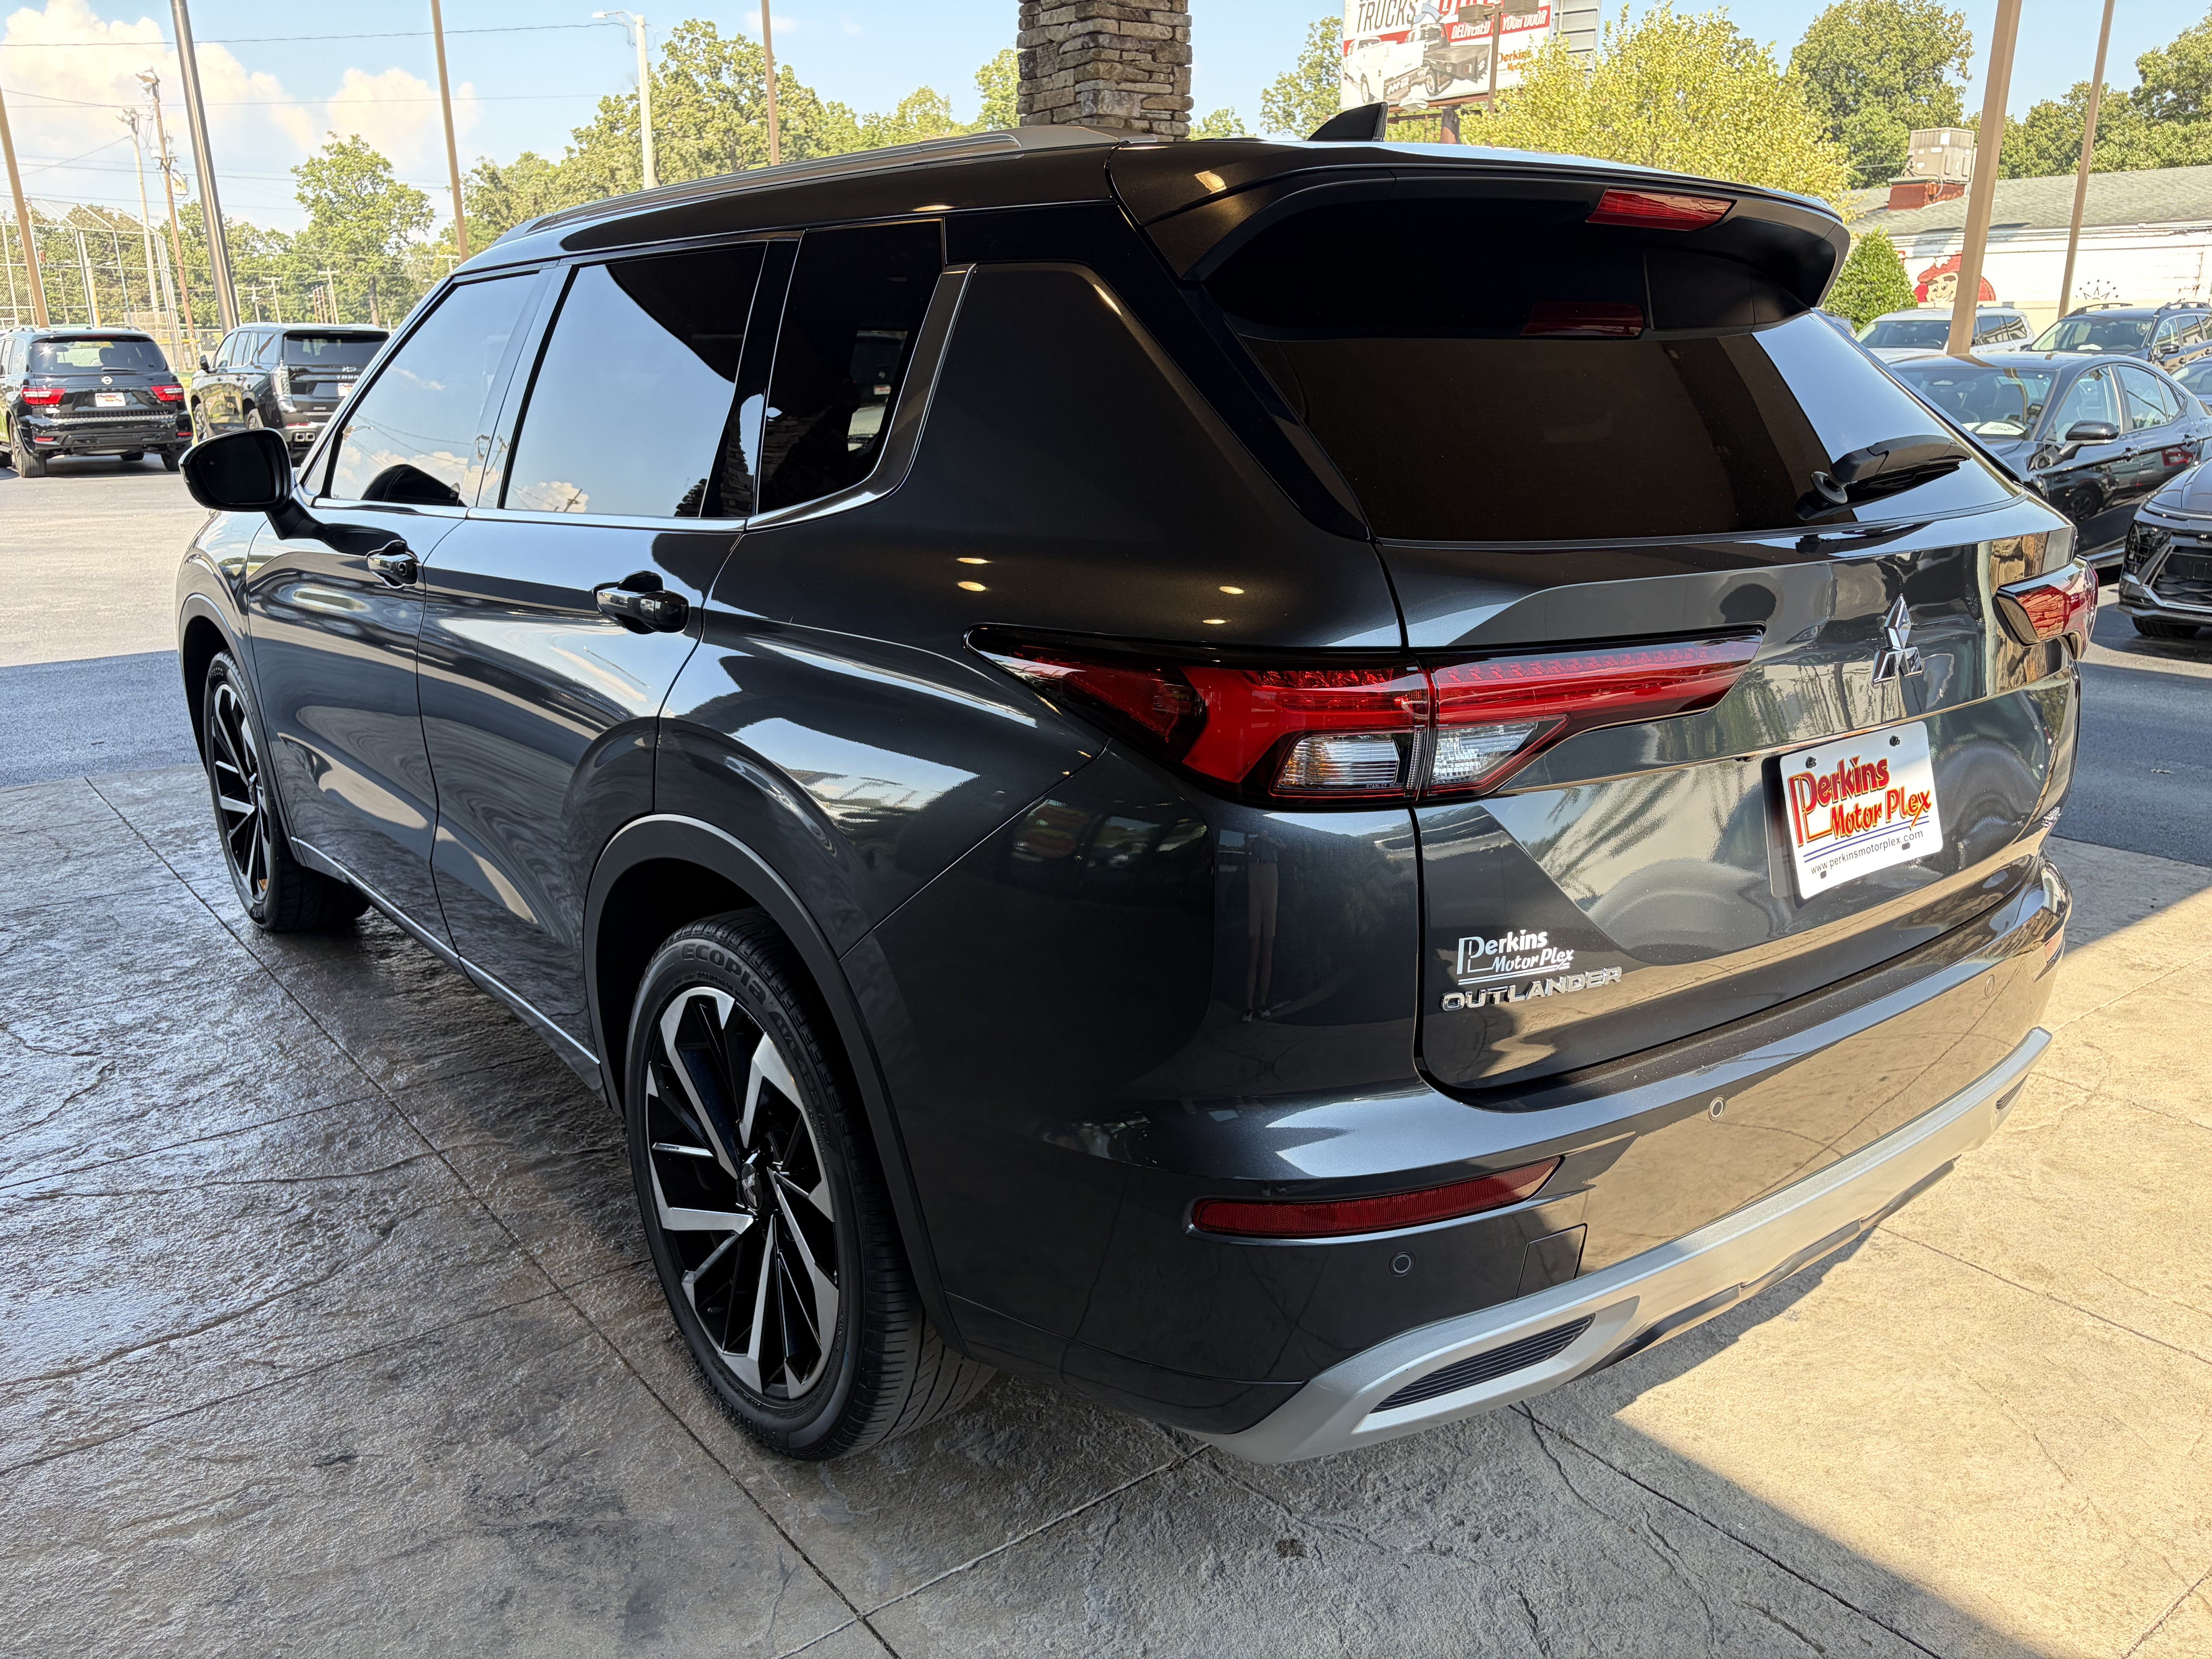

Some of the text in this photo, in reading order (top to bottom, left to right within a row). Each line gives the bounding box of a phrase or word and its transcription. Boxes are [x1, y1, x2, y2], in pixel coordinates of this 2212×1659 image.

[1357, 0, 1415, 33] TRUCKS
[1788, 756, 1890, 847] Perkins
[1830, 786, 1932, 840] Motor Plex
[1811, 830, 1923, 874] www.perkinsmotorplex.com
[1457, 929, 1548, 974] Perkins
[1441, 966, 1622, 1012] OUTLANDER
